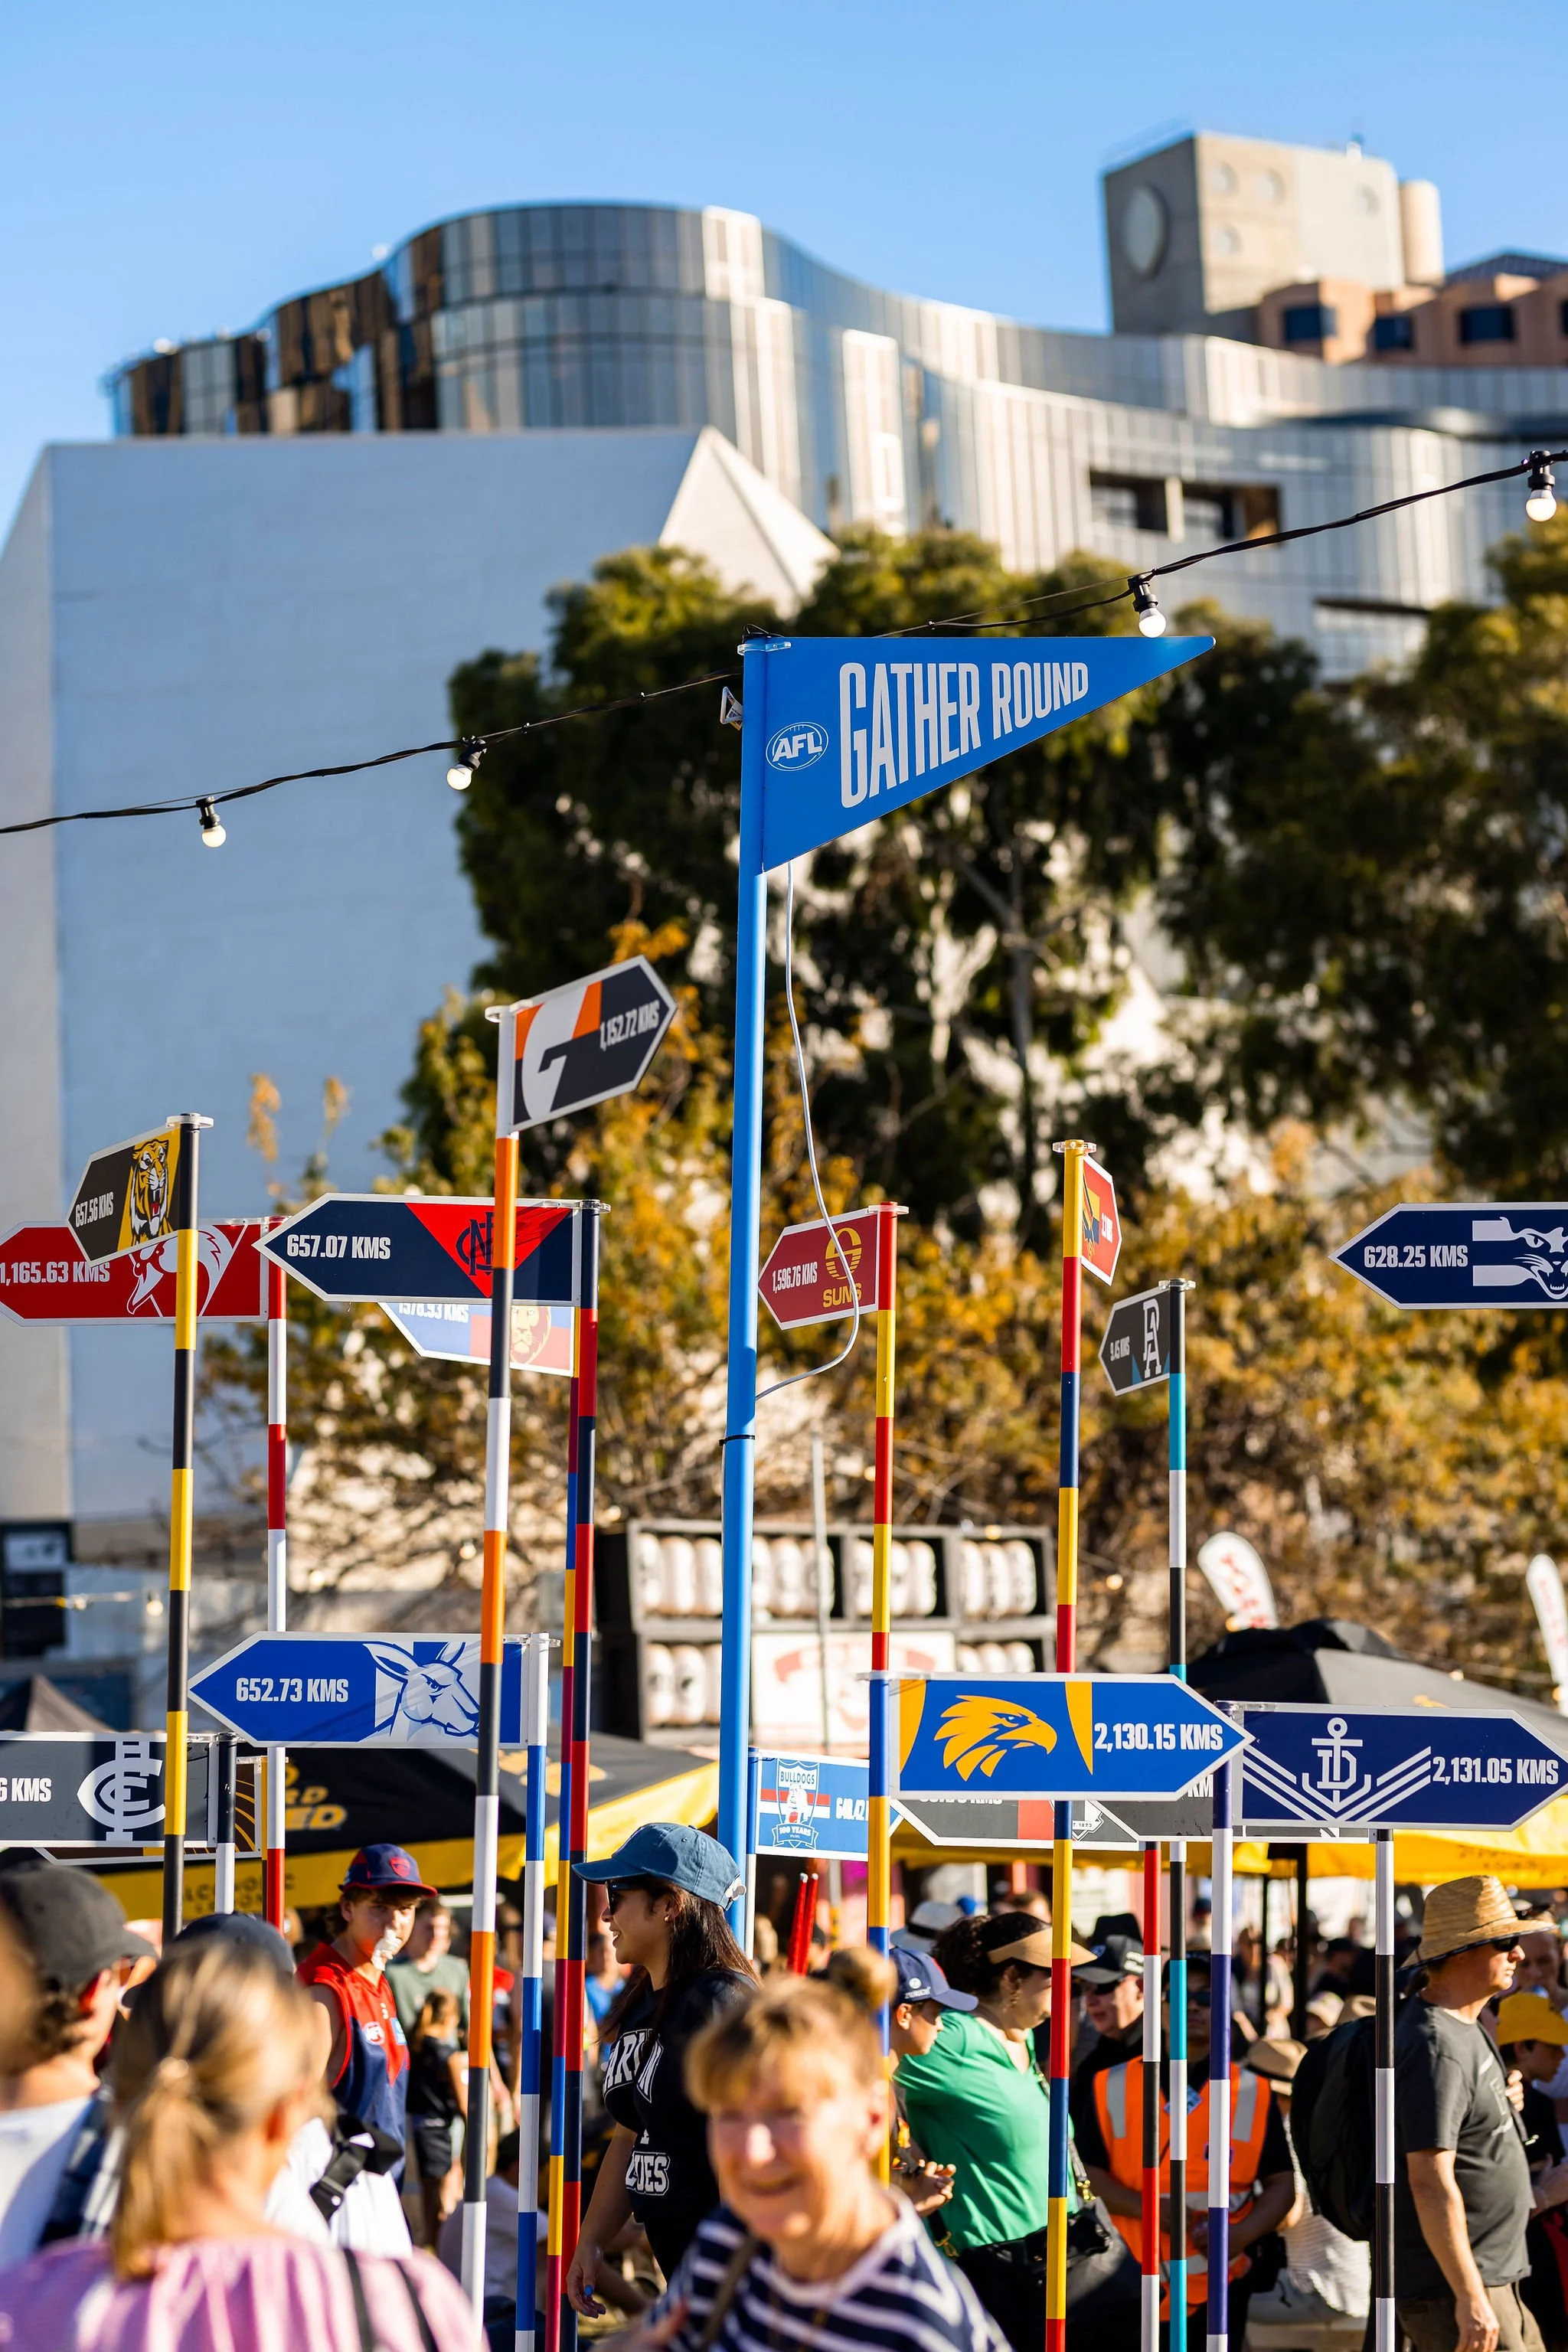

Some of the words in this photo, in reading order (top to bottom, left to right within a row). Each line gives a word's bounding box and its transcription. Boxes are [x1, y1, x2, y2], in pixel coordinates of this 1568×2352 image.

[772, 730, 823, 763] AFL
[839, 662, 982, 808] GATHER
[991, 662, 1089, 740] ROUND
[638, 999, 660, 1034] KMS
[75, 1199, 98, 1228] 657.56
[99, 1191, 114, 1220] KMS
[286, 1234, 348, 1258] 657.07
[351, 1236, 391, 1259] KMS
[1364, 1245, 1426, 1268] 628.25
[1429, 1245, 1468, 1268] KMS
[0, 1262, 69, 1286] 1,165.63
[73, 1261, 110, 1283] KMS
[772, 1265, 801, 1294] 1,596.76
[802, 1261, 818, 1285] KMS
[236, 1677, 302, 1703] 652.73
[307, 1678, 349, 1703] KMS
[1094, 1722, 1176, 1753] 2,130.15
[1180, 1723, 1223, 1751] KMS
[779, 1771, 815, 1785] BULLDOGS
[1432, 1756, 1513, 1786] 2,131.05
[1517, 1759, 1559, 1785] KMS
[11, 1777, 52, 1802] KMS
[779, 1826, 790, 1835] 100
[791, 1825, 812, 1837] YEARS
